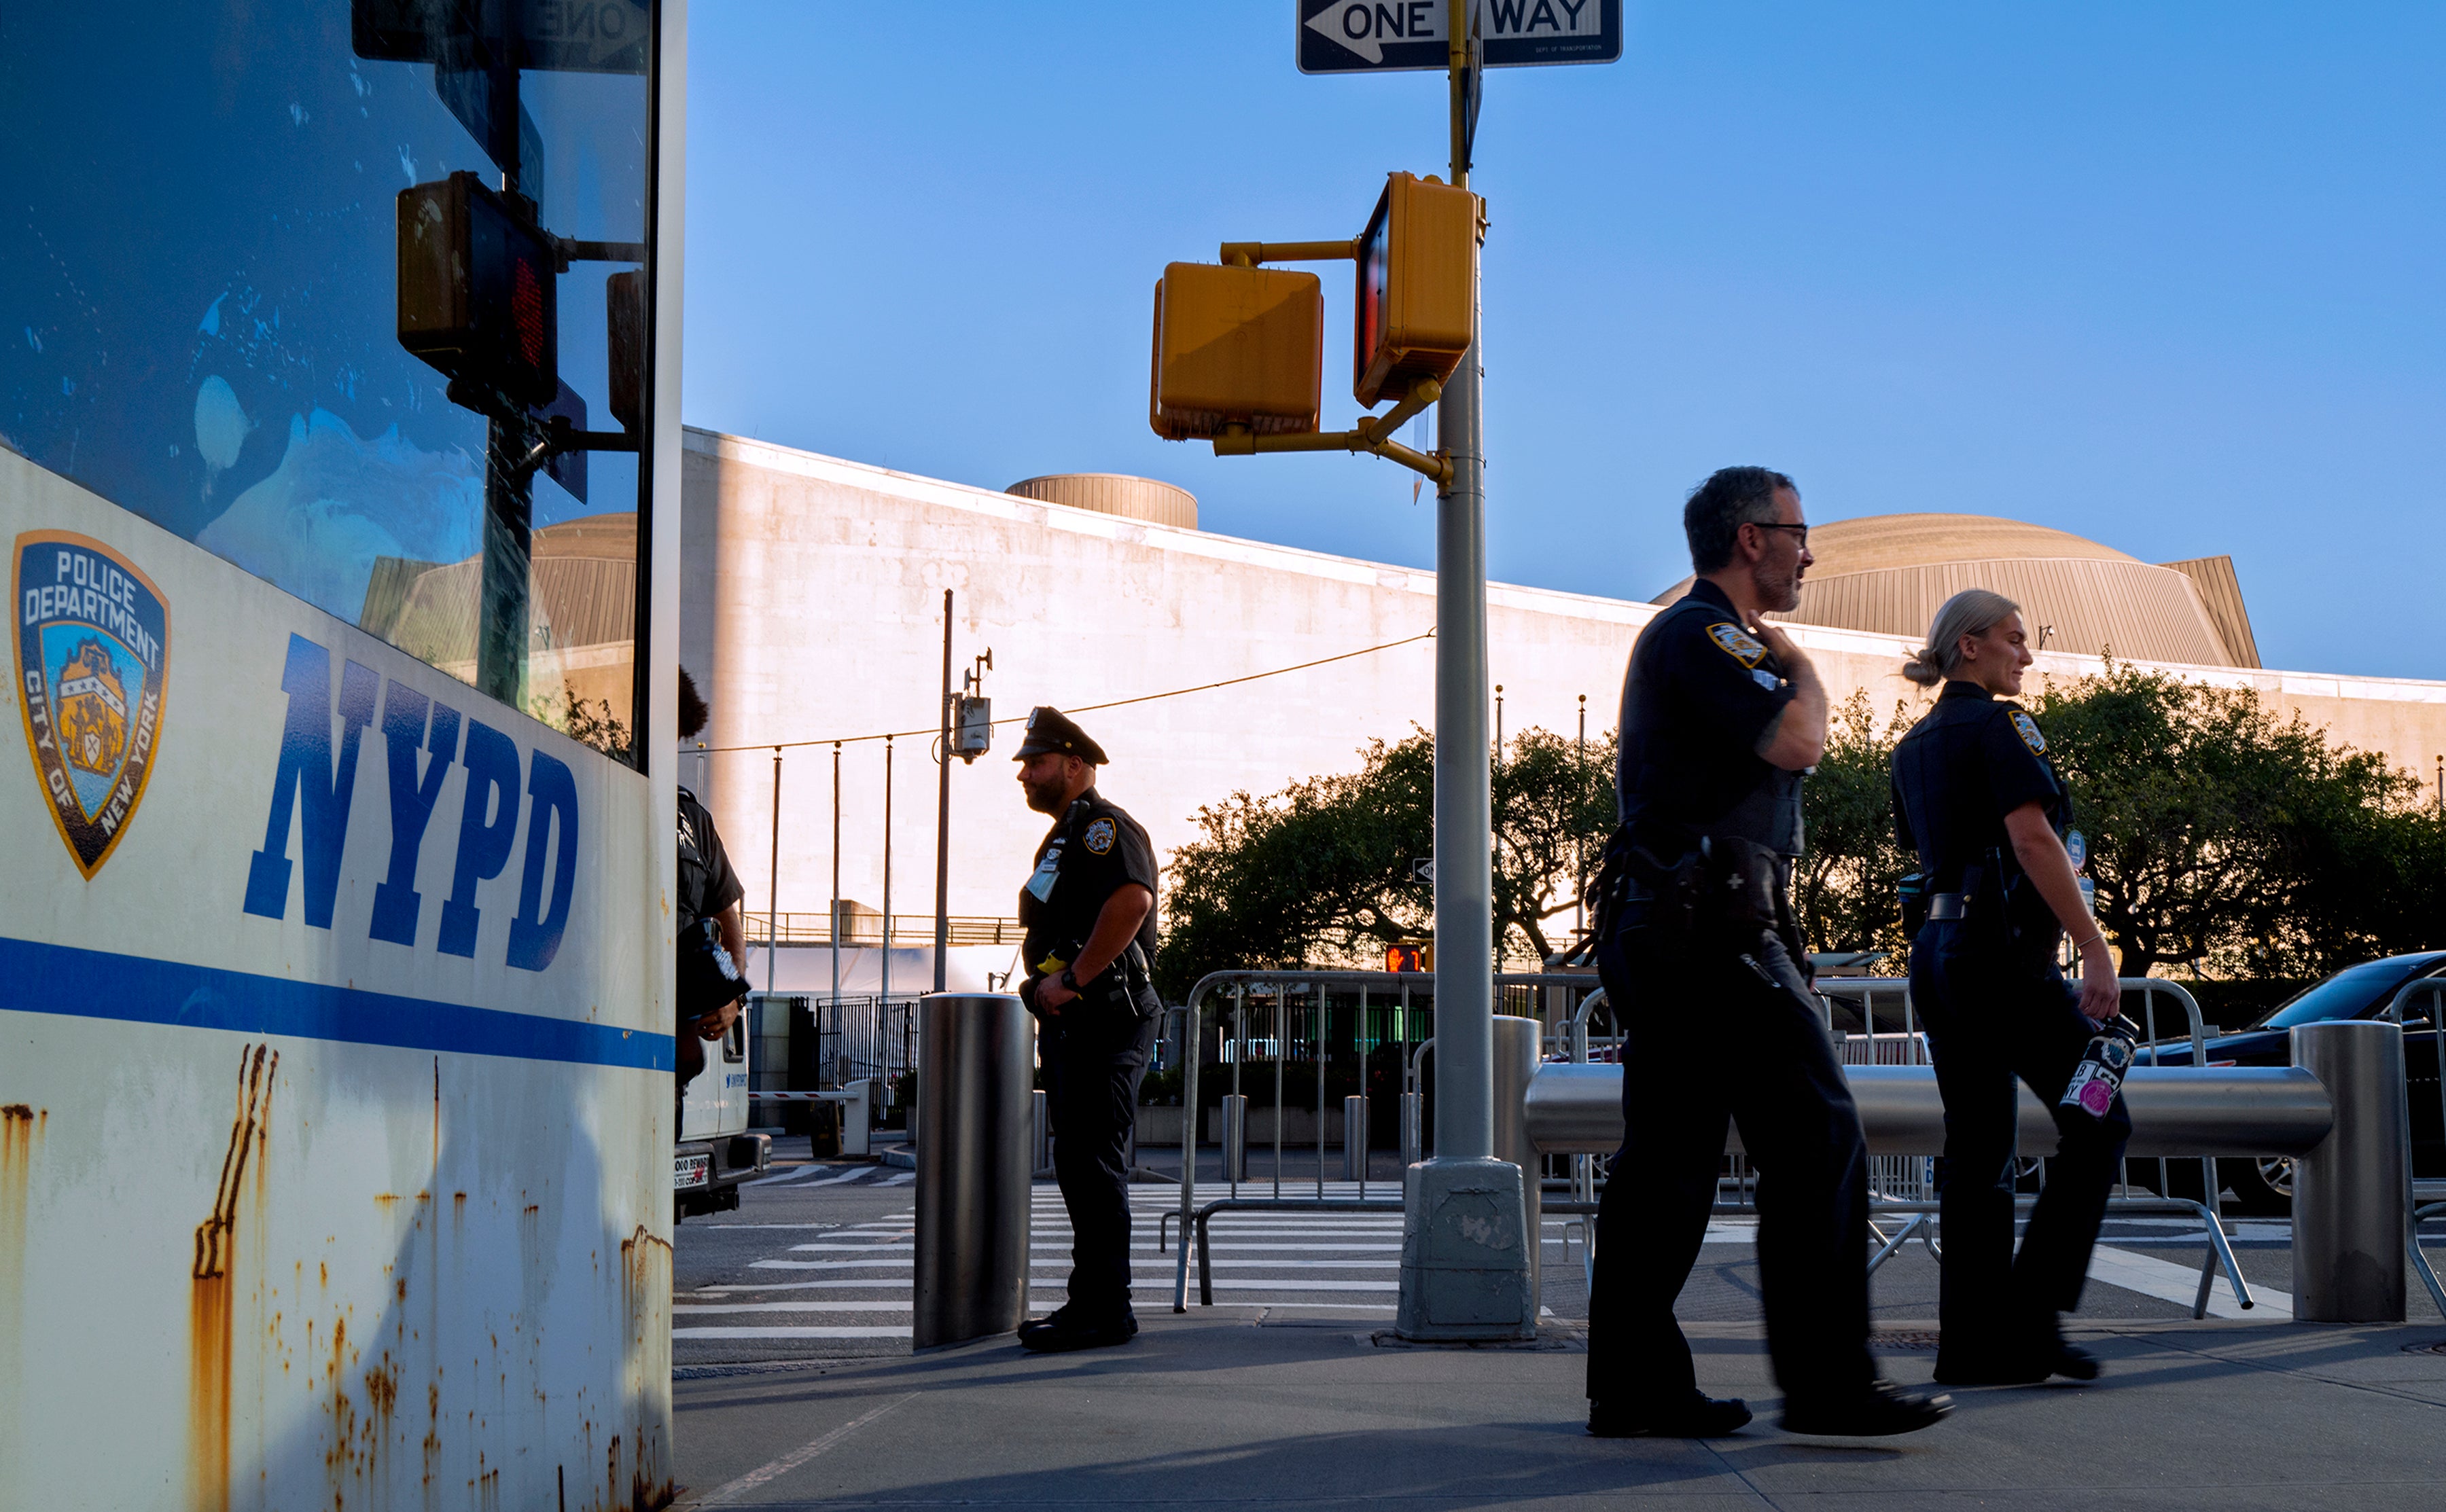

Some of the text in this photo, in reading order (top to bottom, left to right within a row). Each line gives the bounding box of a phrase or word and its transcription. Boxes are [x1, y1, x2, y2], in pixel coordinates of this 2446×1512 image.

[1342, 0, 1586, 39] ONE WAY
[1560, 44, 1602, 52] TRANSPORTATION
[56, 550, 137, 615] POLICE
[25, 586, 160, 671] DEPARTMENT
[26, 670, 73, 810] CITY OF
[100, 690, 158, 838] NEW YORK
[243, 631, 579, 973] NYPD
[1411, 950, 1419, 971] 7
